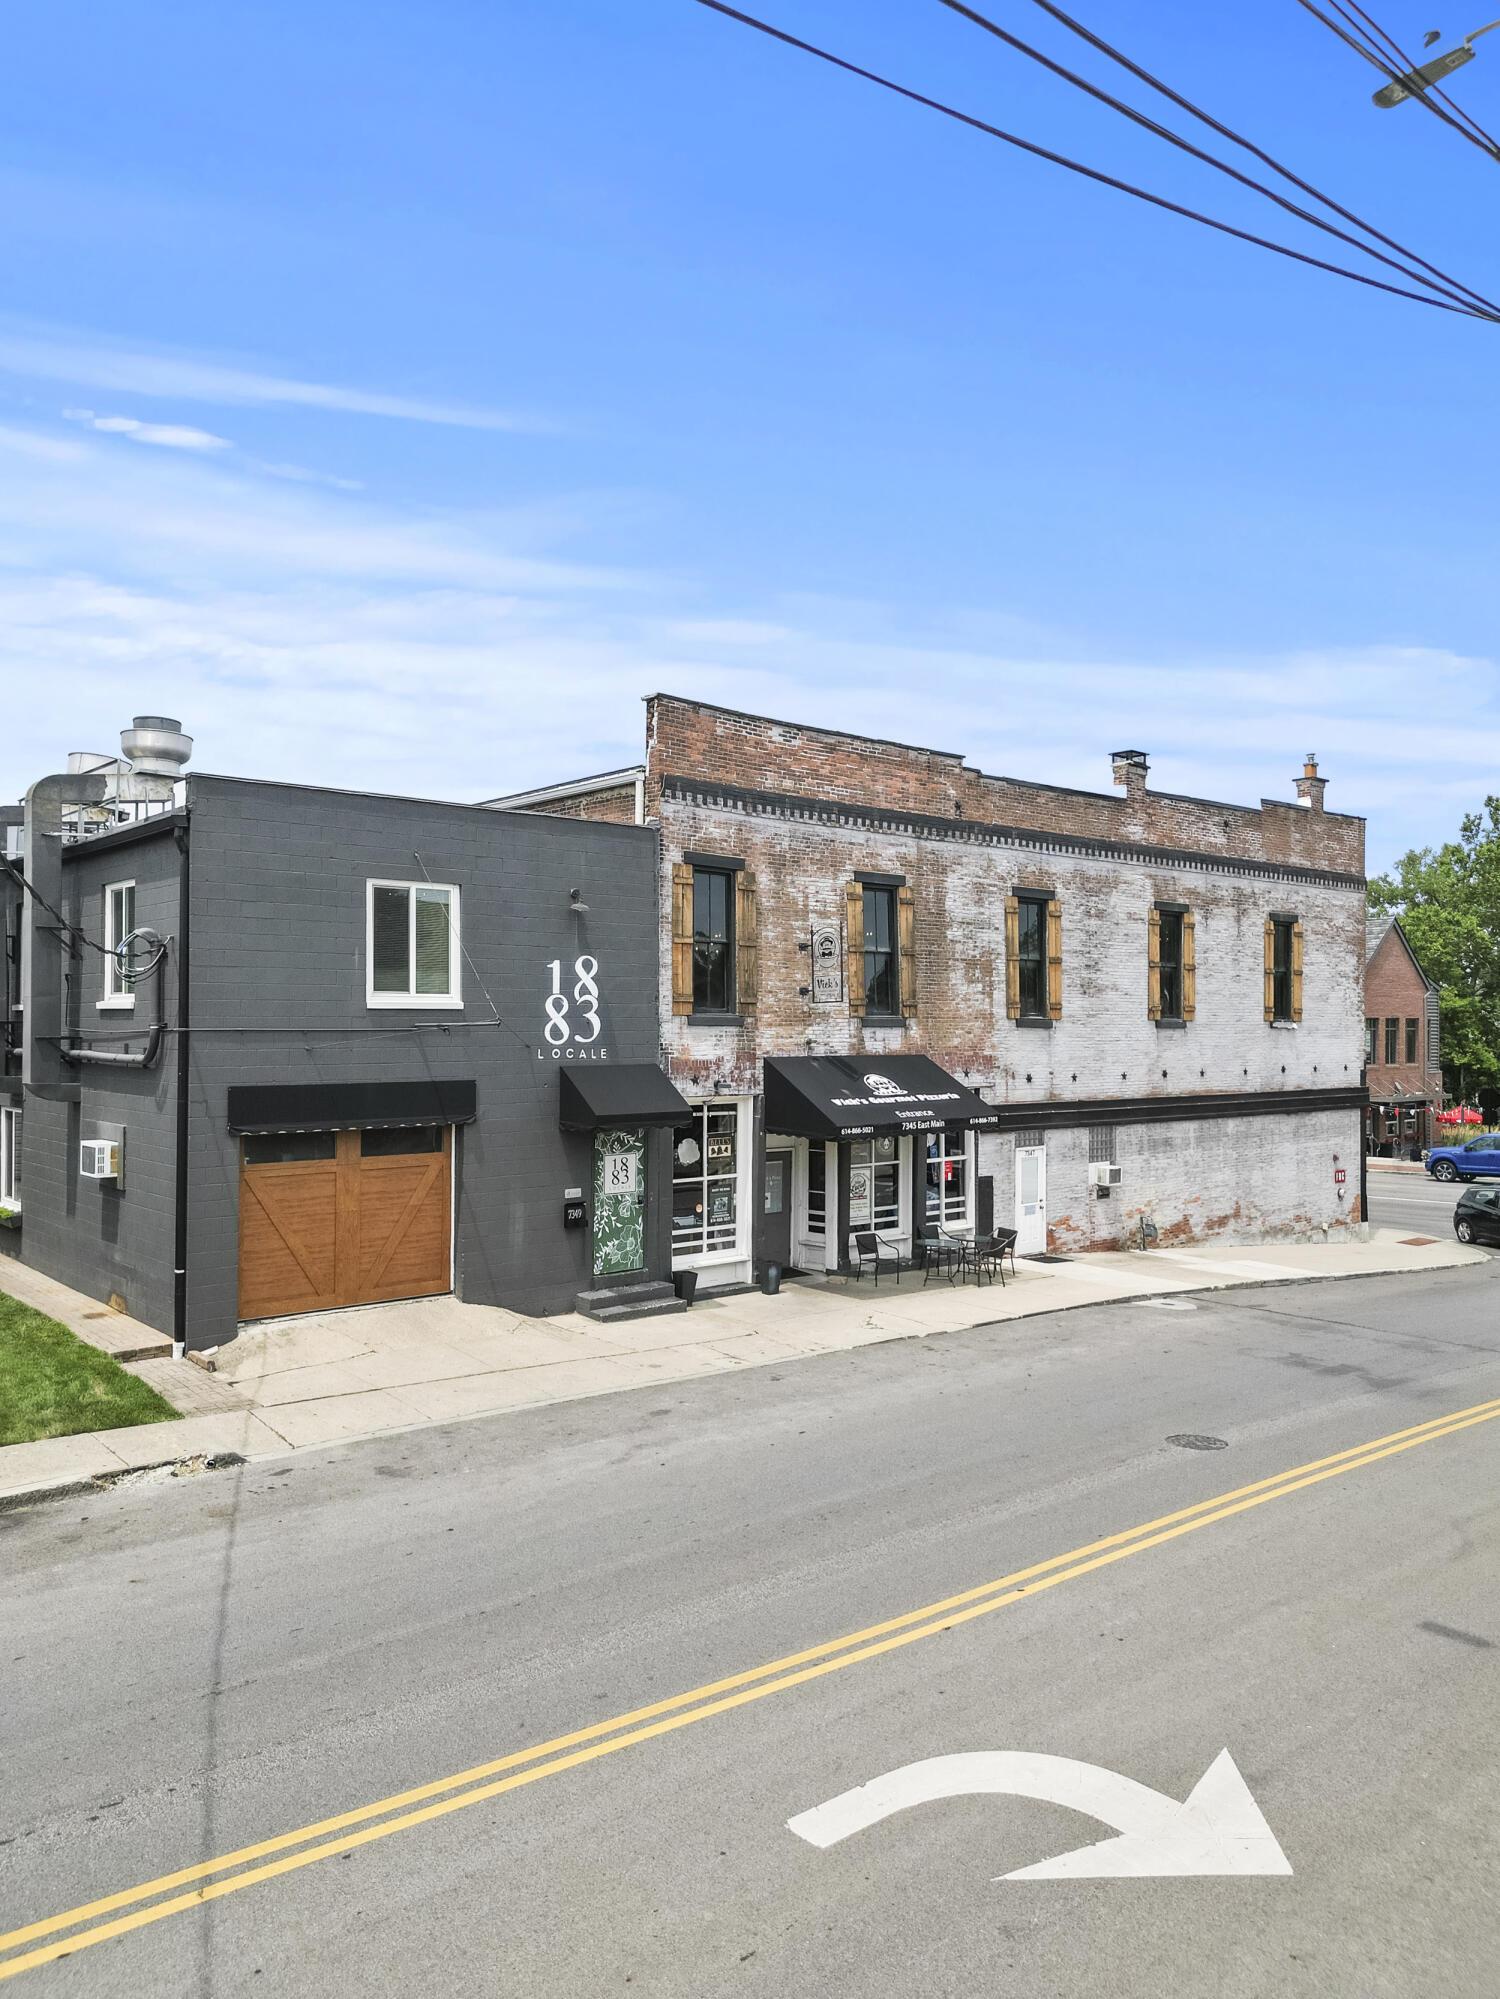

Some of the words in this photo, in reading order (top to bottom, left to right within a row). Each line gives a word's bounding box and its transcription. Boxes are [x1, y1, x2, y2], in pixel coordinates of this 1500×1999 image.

[546, 955, 599, 1001] 18
[816, 978, 839, 989] Vick's
[544, 994, 601, 1045] 83
[537, 1048, 608, 1059] LOCALE
[830, 1097, 869, 1106] Vick's
[868, 1095, 918, 1104] Gourmet
[915, 1092, 961, 1101] Pizzeria
[894, 1110, 935, 1118] Entrance
[901, 1121, 917, 1130] 7345
[917, 1120, 931, 1129] East
[930, 1119, 945, 1128] Main
[613, 1157, 629, 1171] 18
[611, 1167, 630, 1185] 83
[567, 1209, 582, 1220] 7349
